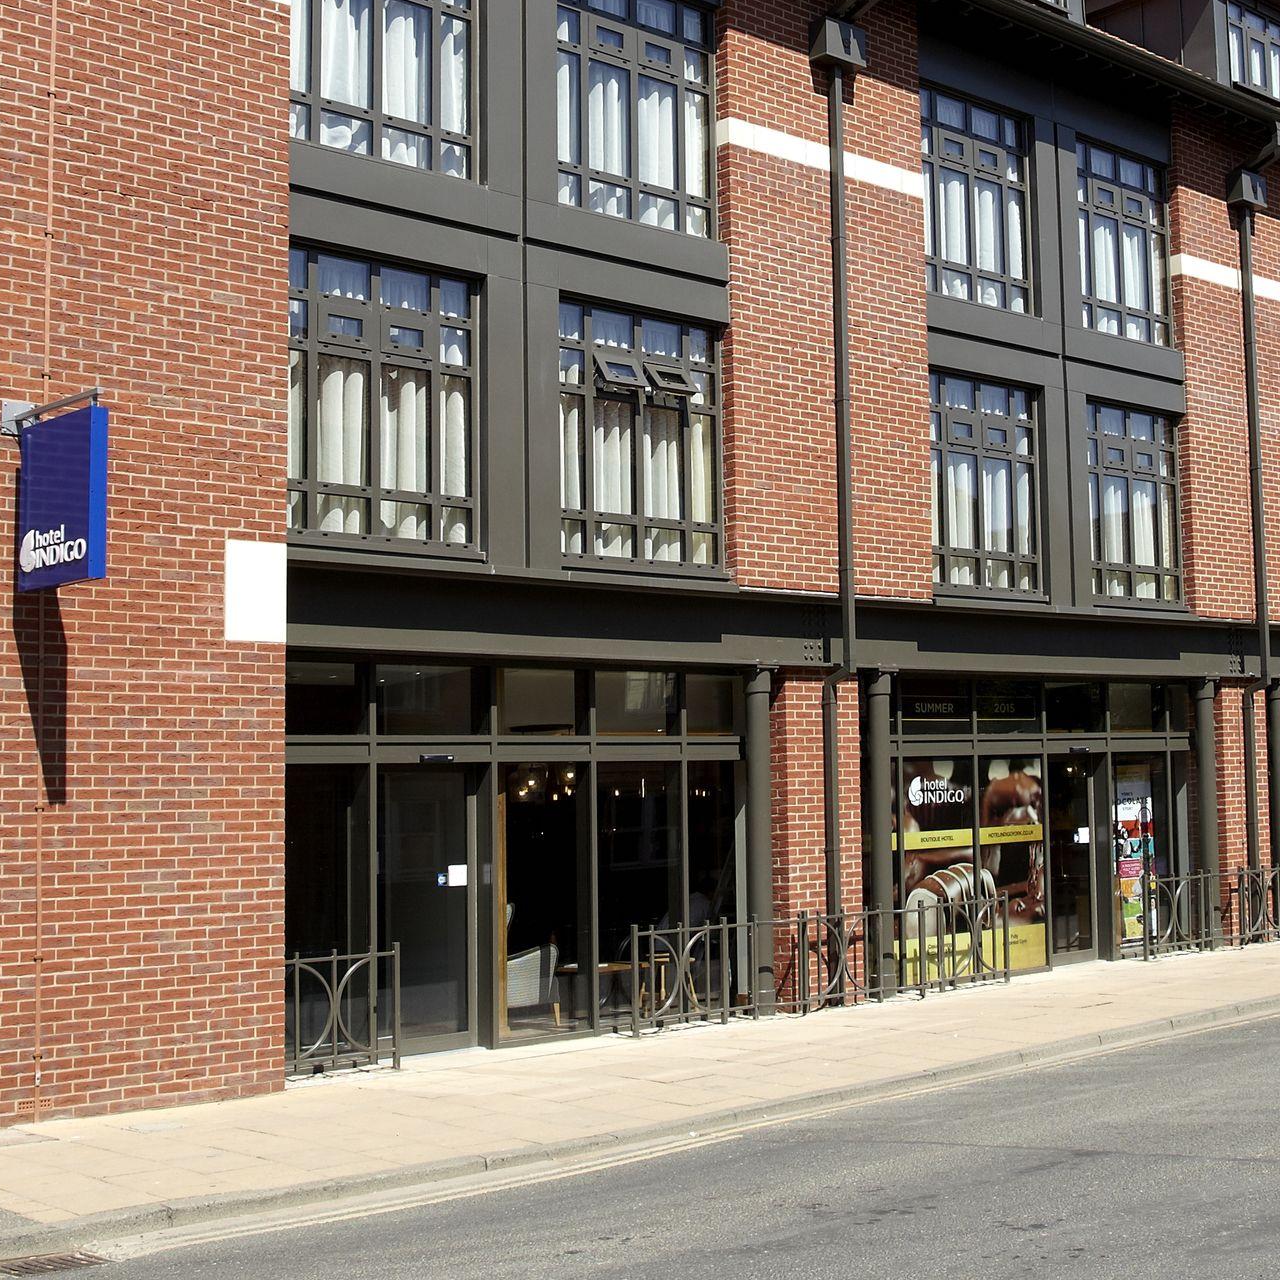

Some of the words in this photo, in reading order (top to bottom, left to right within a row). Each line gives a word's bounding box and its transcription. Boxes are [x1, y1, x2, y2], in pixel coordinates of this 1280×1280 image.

[35, 524, 65, 548] hotel
[35, 538, 87, 569] INDIGO
[915, 703, 954, 713] SUMMER
[994, 703, 1016, 713] 2015
[923, 777, 948, 790] hotel
[924, 790, 964, 804] INDIGO
